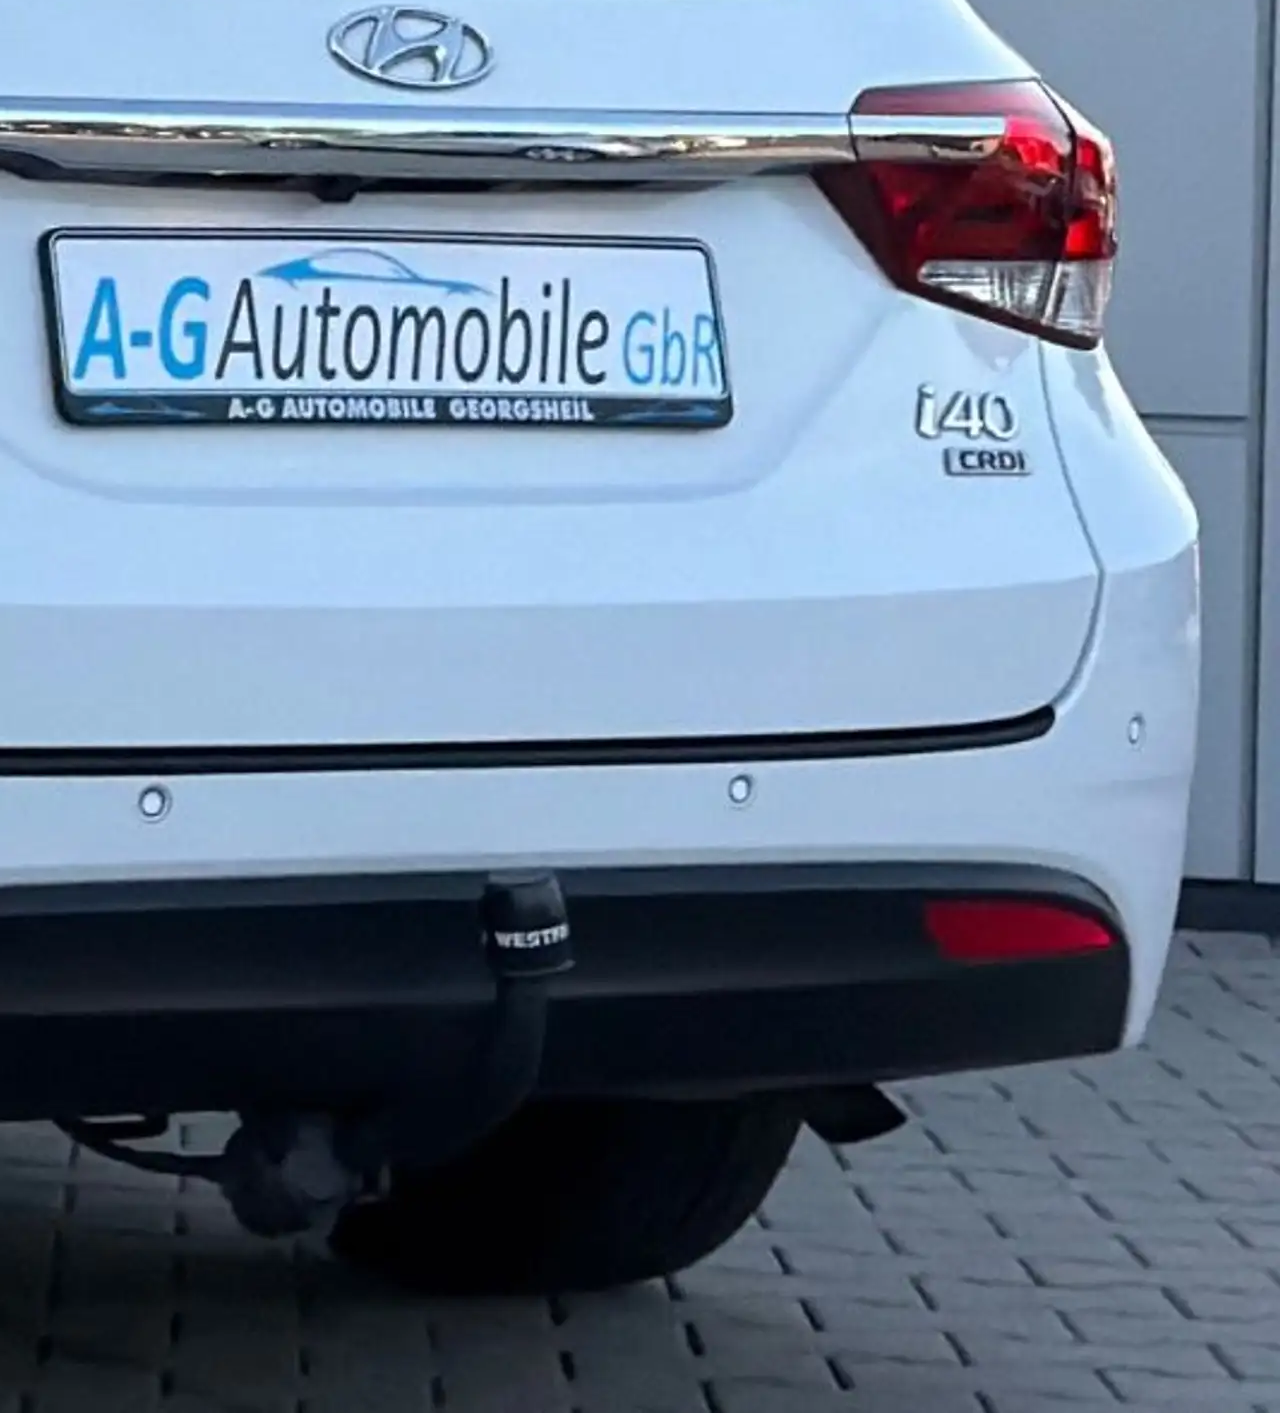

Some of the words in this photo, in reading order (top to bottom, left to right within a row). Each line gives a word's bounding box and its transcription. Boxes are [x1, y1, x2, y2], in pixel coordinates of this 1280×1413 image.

[71, 274, 213, 382] A-G
[214, 276, 611, 386] Automobile
[621, 304, 719, 388] GbR
[228, 398, 276, 420] A-G
[281, 396, 437, 420] AUTOMOBILE
[448, 398, 595, 422] GEORGSHEIL
[915, 383, 1019, 441] i40
[957, 449, 1026, 471] CRDI
